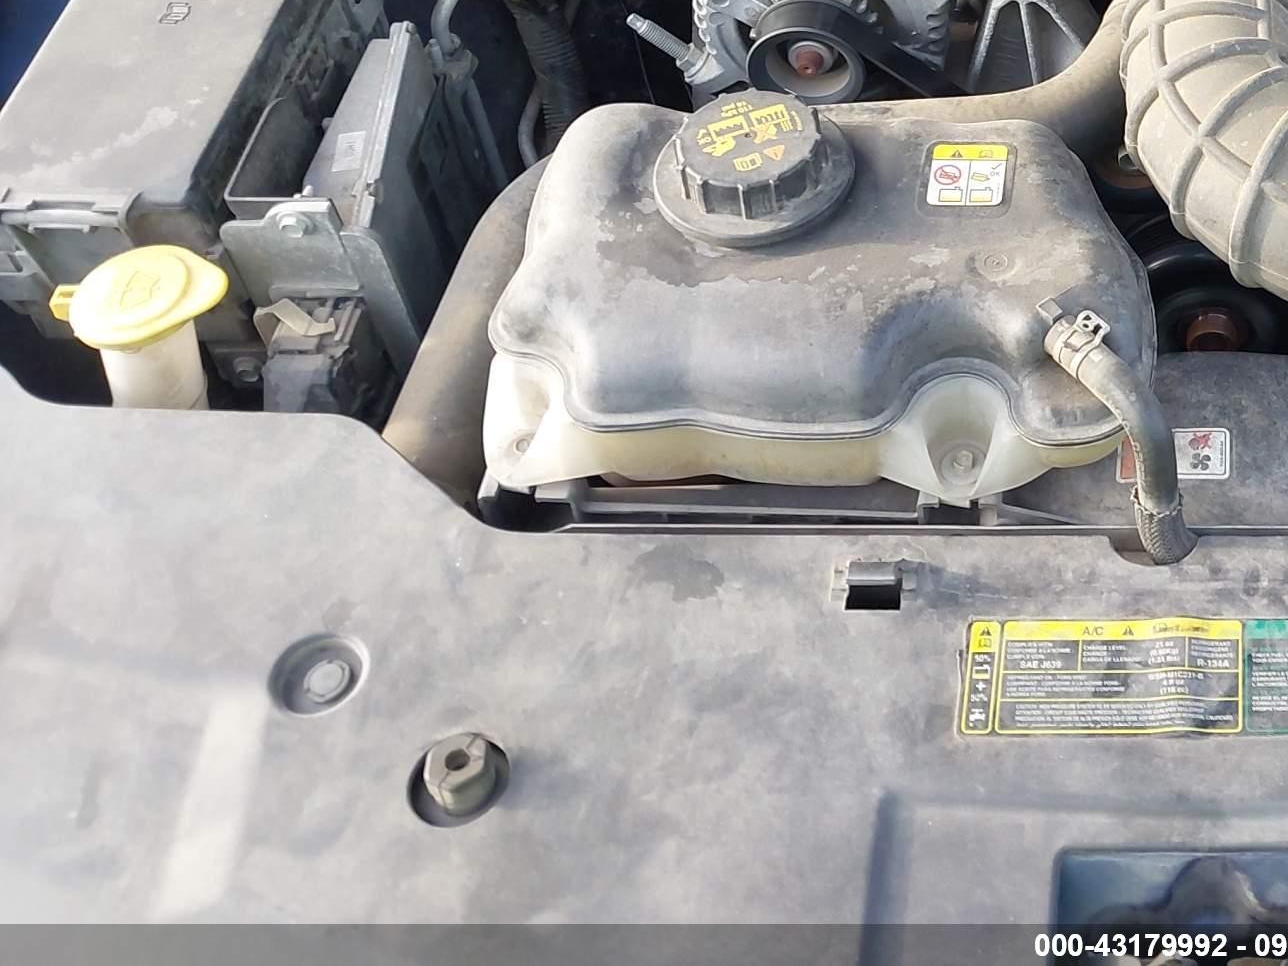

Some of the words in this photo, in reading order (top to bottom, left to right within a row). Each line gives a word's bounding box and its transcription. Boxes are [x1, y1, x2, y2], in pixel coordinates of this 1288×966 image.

[1082, 626, 1104, 636] A/C
[974, 654, 991, 662] 50%
[1019, 660, 1039, 669] SAE
[1040, 660, 1062, 669] J639
[1196, 658, 1230, 669] R-134A
